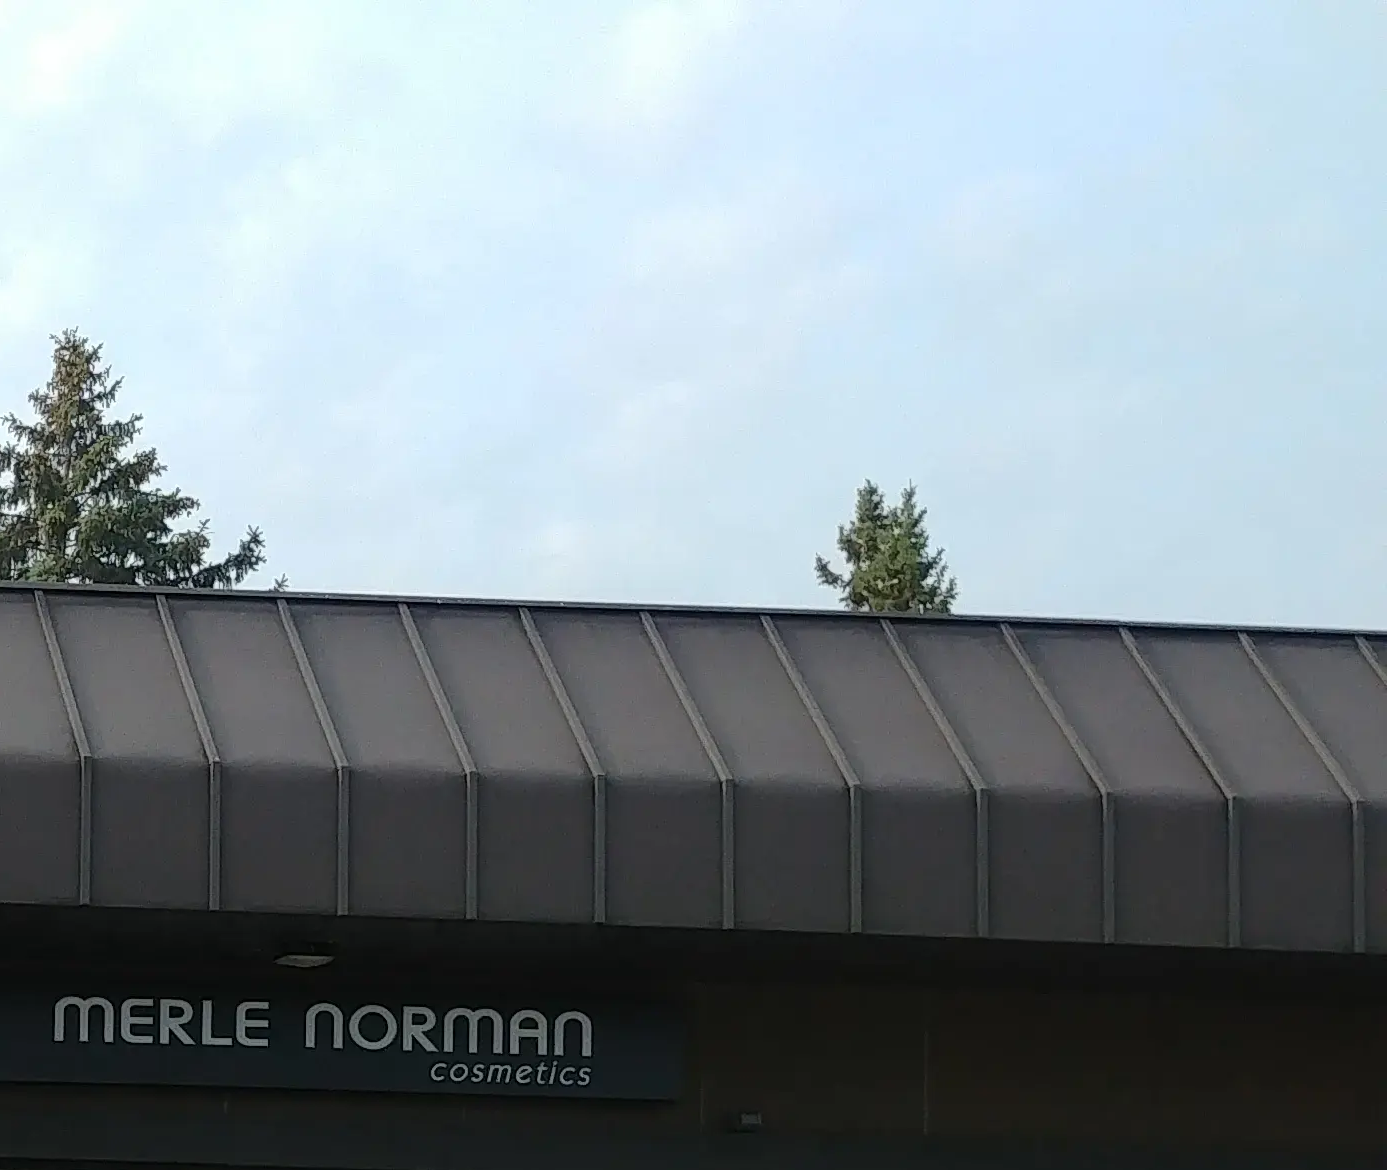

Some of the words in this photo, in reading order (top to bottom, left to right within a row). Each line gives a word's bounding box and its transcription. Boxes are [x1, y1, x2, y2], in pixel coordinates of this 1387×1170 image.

[53, 995, 270, 1048] MERLE
[304, 1002, 593, 1057] NORMAN
[431, 1059, 593, 1086] cosmetics
